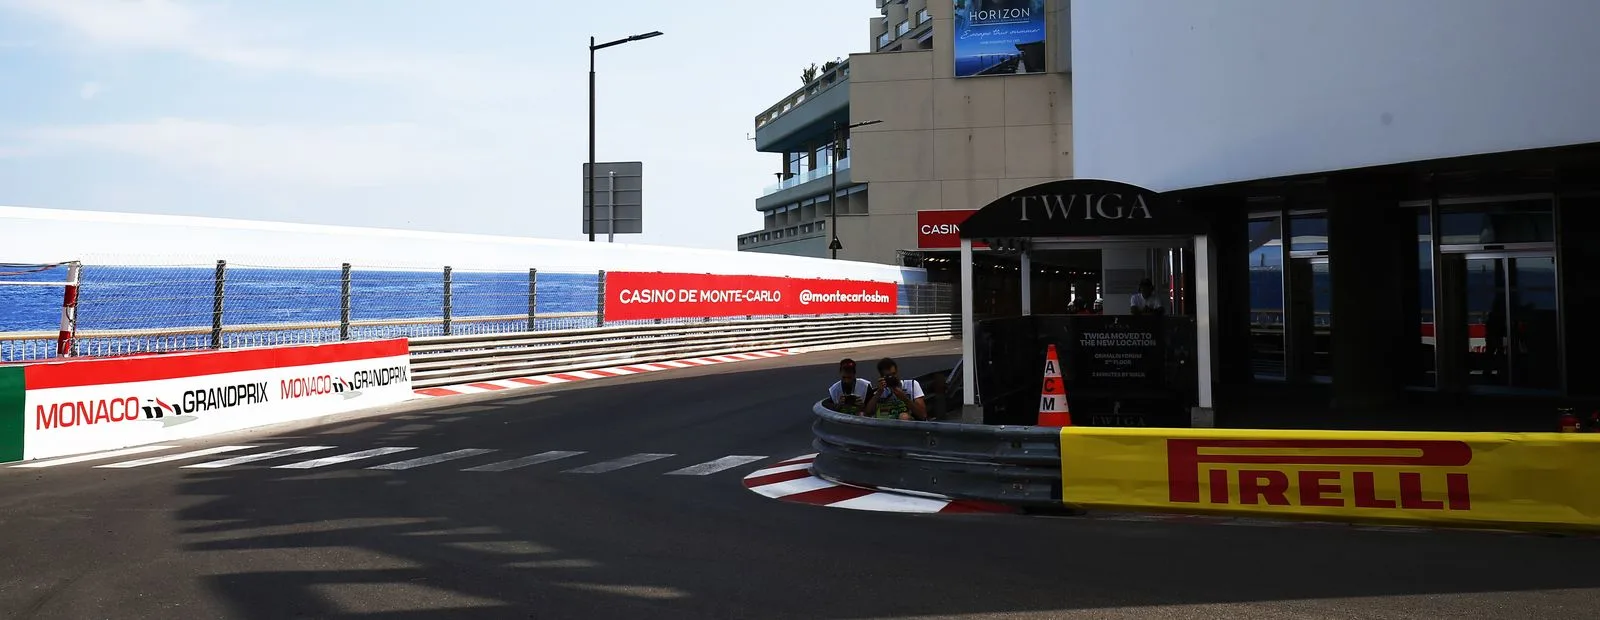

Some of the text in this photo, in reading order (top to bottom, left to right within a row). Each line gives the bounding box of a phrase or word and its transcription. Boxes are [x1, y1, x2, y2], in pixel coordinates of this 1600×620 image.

[969, 7, 1030, 21] HORIZON
[1011, 192, 1153, 222] TWIGA
[921, 224, 960, 235] CASIN
[619, 288, 781, 304] CASINO DE MONTE-CARLO
[799, 289, 889, 305] @montecarlosbm
[1079, 339, 1157, 347] THE NEW LOCATION
[1083, 332, 1152, 340] TWIGA MOVED TO
[280, 365, 408, 400] MONACO GRANDPRIX
[35, 381, 269, 430] MONACO GRANDPRIX
[1166, 438, 1473, 510] PIRELLI
